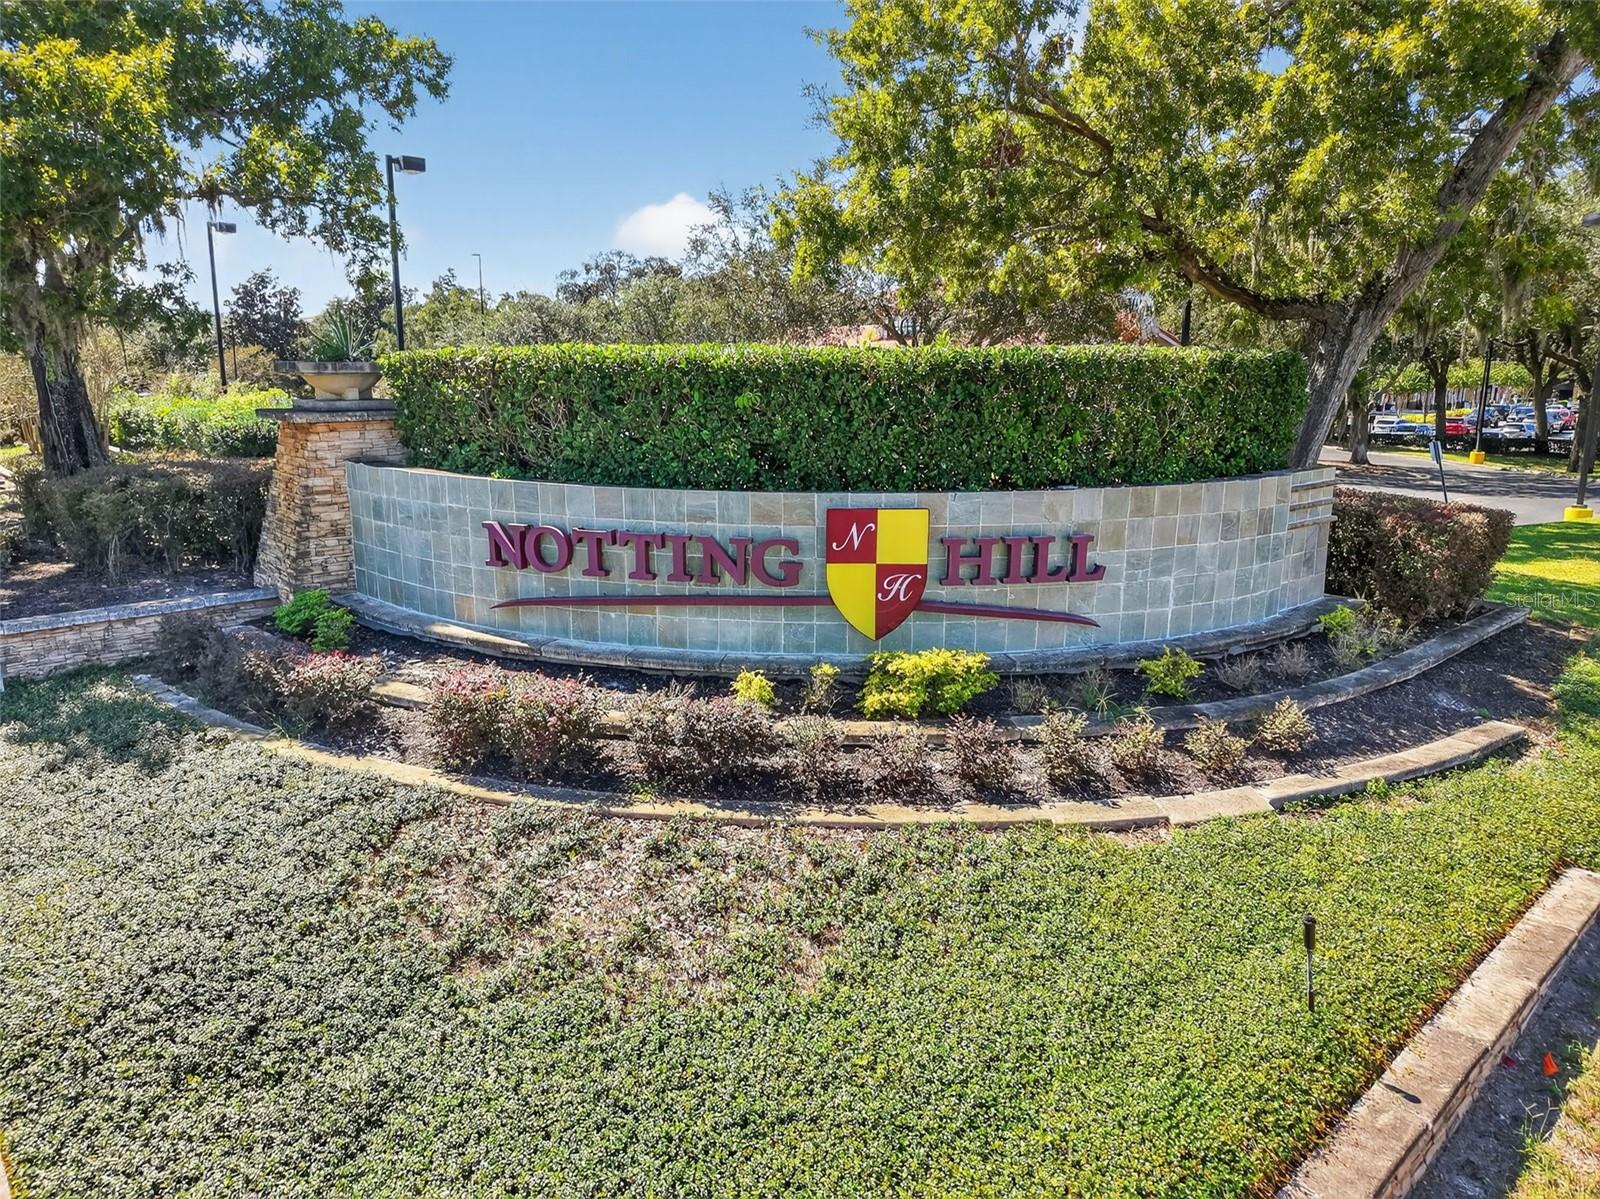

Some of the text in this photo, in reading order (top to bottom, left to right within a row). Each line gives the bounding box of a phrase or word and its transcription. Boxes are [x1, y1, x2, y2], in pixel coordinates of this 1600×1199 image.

[832, 522, 875, 551] N
[482, 520, 1106, 587] NOTTING HILL
[877, 573, 921, 601] H
